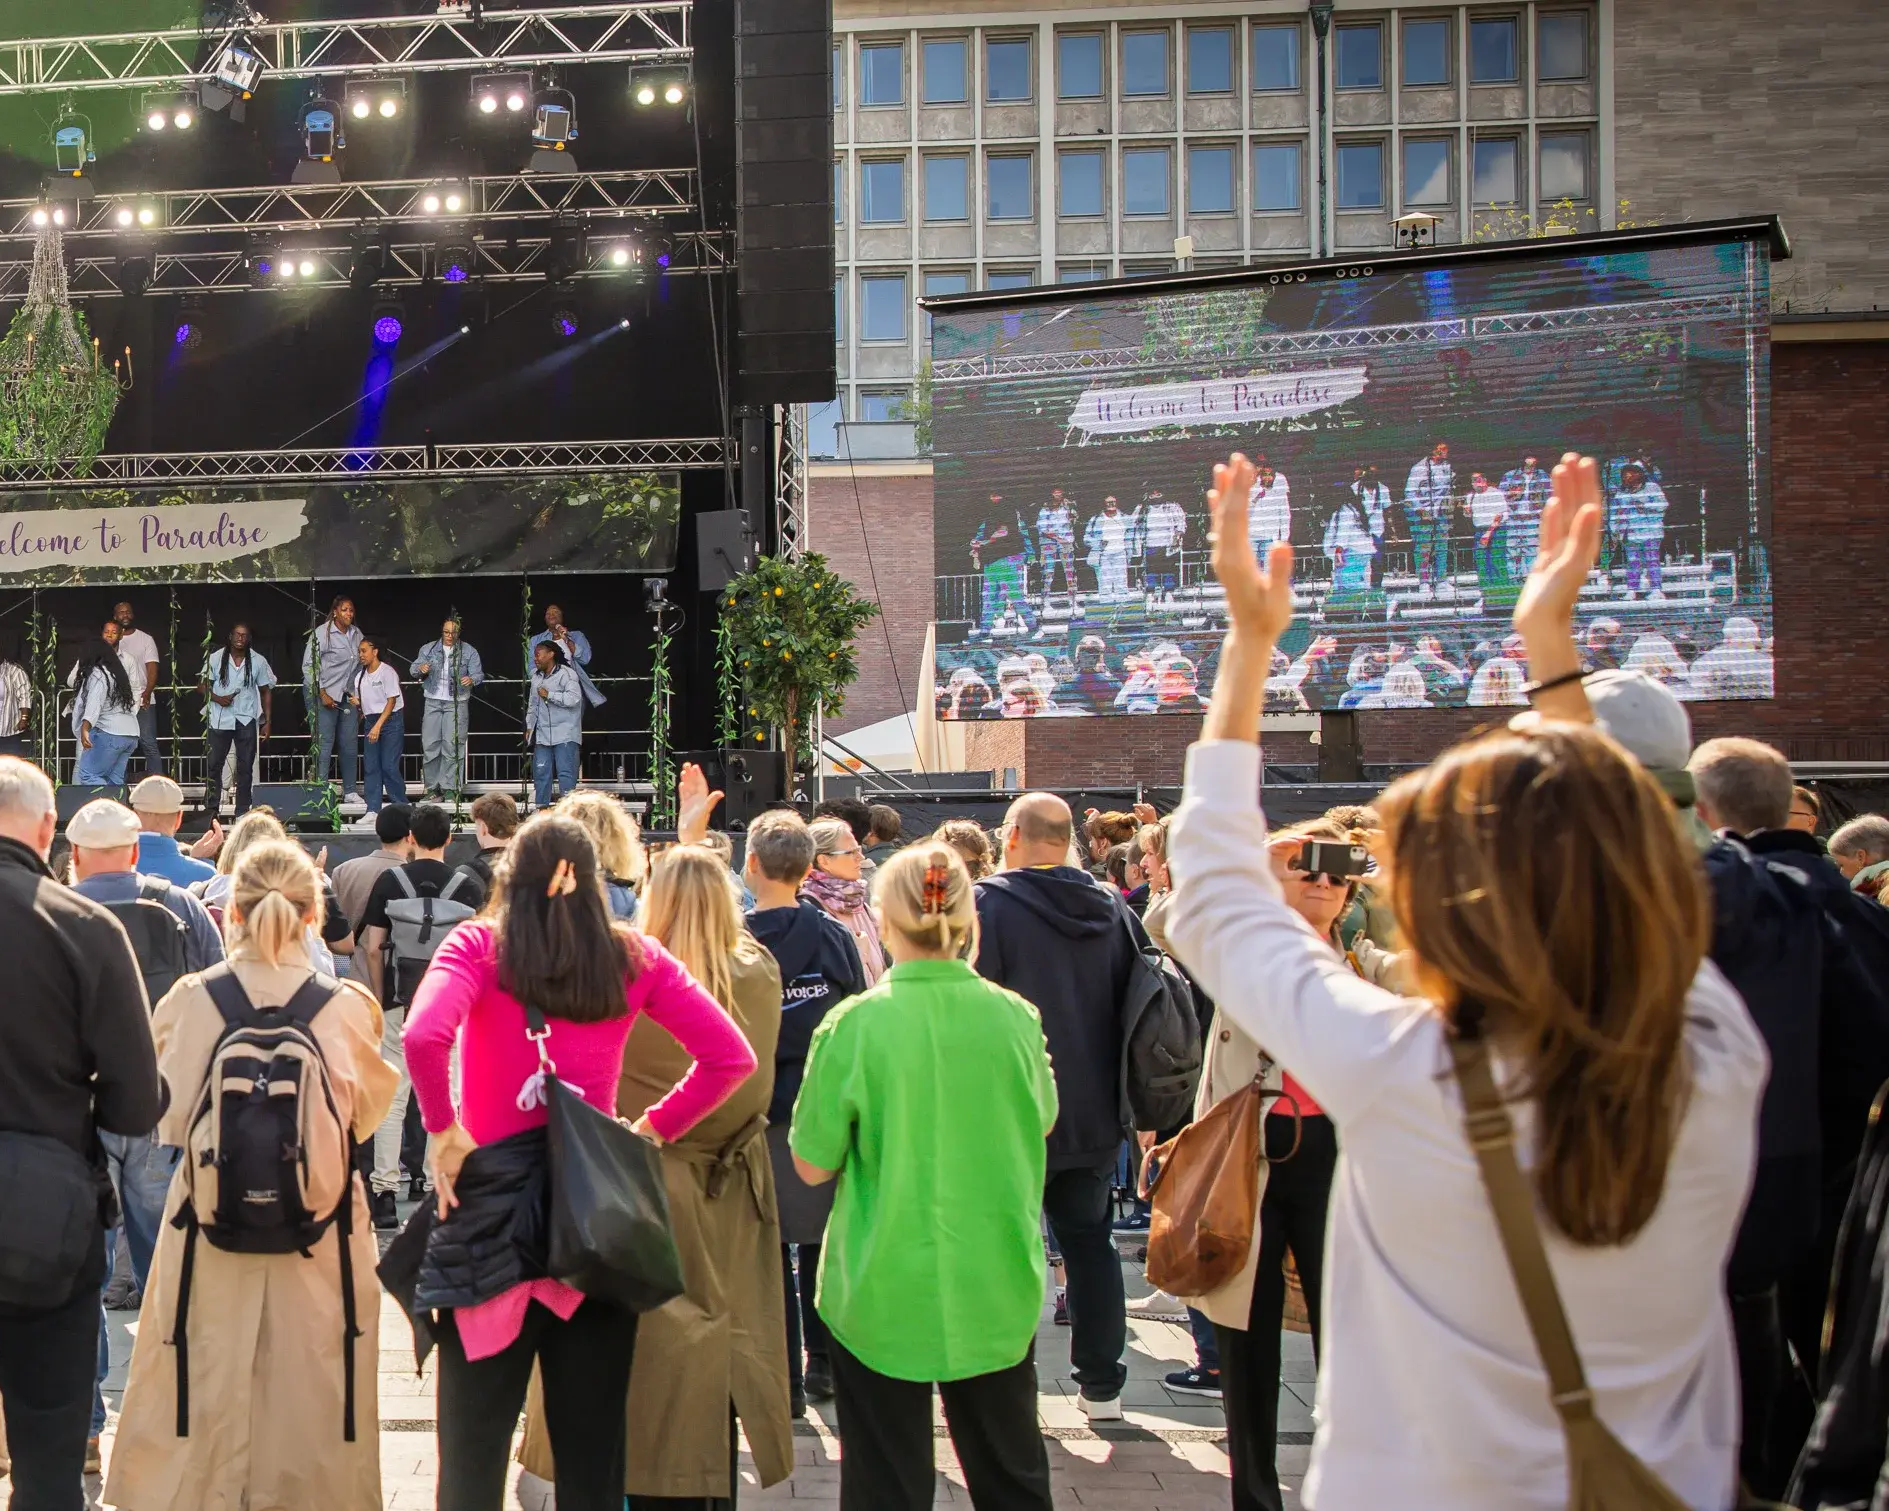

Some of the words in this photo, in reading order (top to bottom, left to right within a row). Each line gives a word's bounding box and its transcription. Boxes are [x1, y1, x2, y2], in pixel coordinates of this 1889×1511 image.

[1231, 378, 1333, 413] Paradise
[92, 517, 126, 555] to
[138, 511, 269, 554] Paradise
